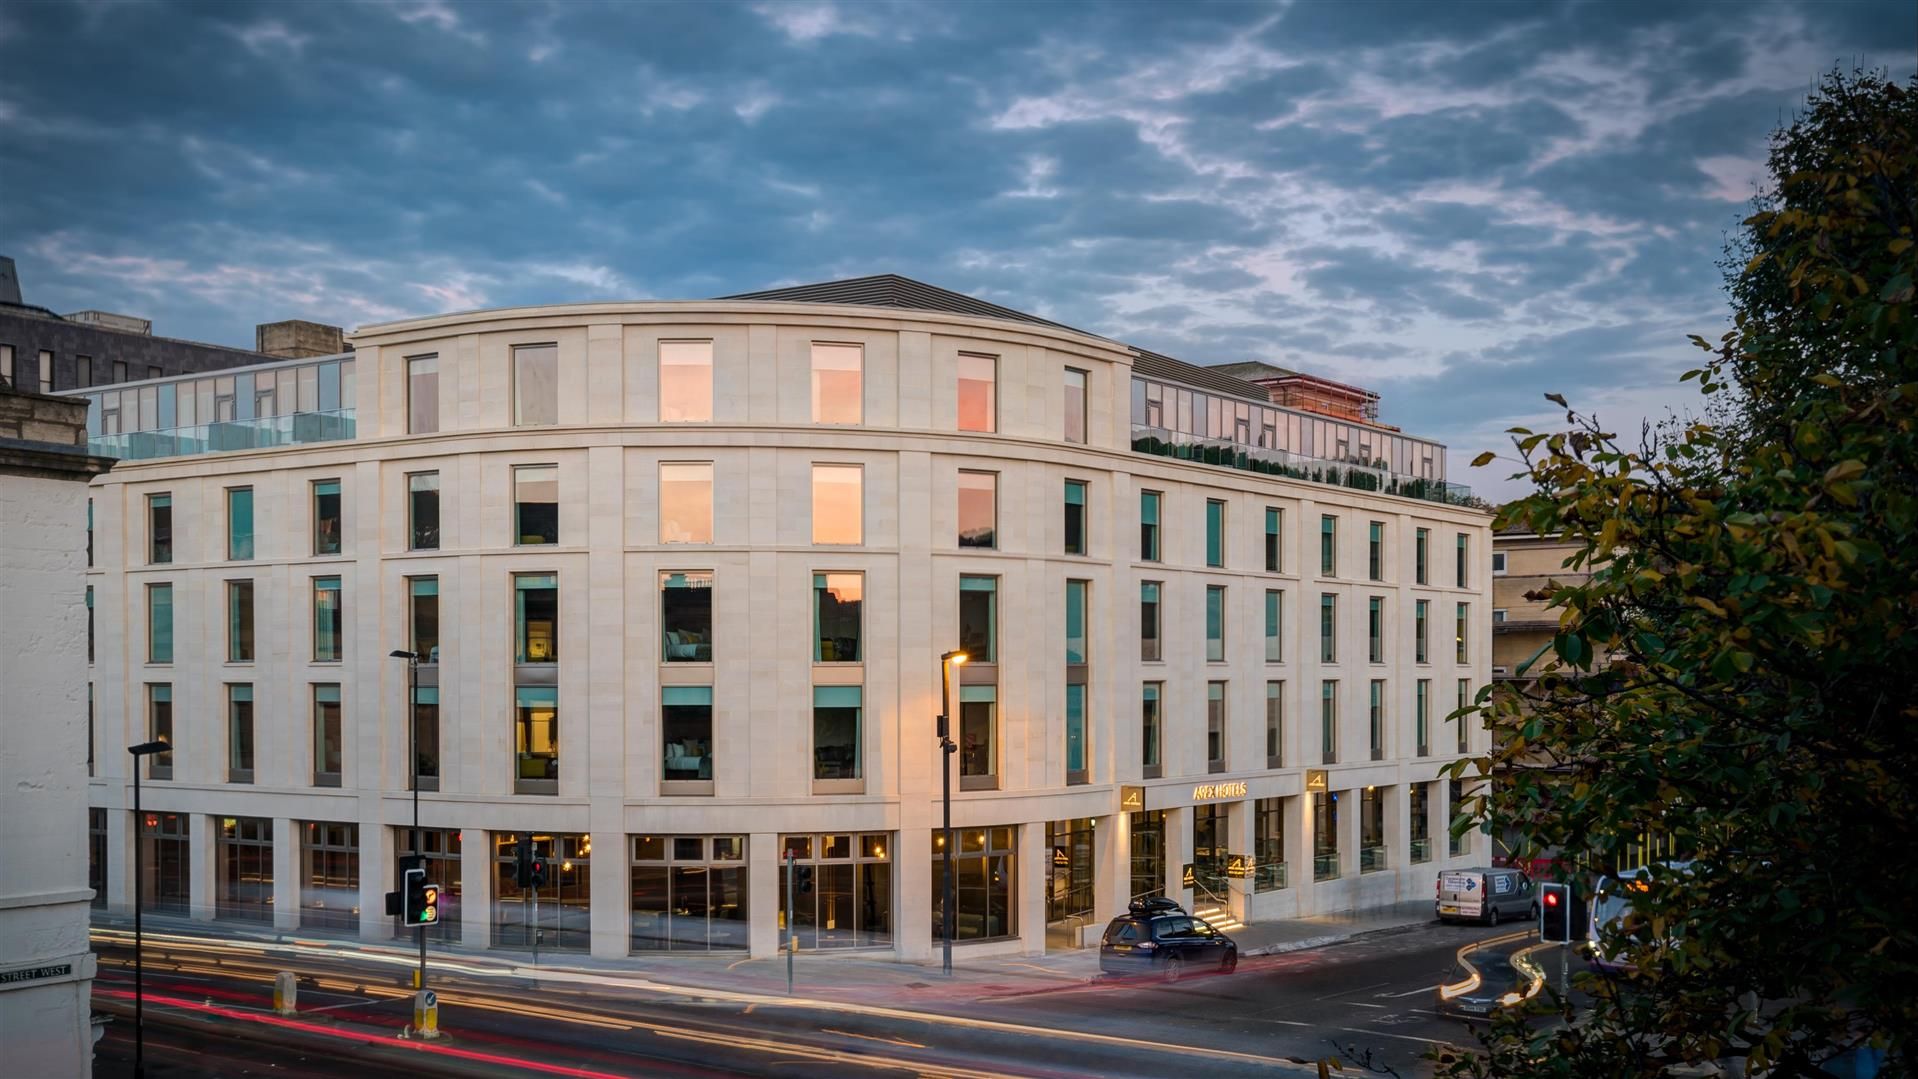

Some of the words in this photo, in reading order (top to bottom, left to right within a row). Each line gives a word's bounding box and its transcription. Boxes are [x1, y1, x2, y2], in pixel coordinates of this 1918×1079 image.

[1215, 782, 1247, 799] HOTELS
[0, 969, 37, 983] STREET
[41, 966, 67, 977] WEST
